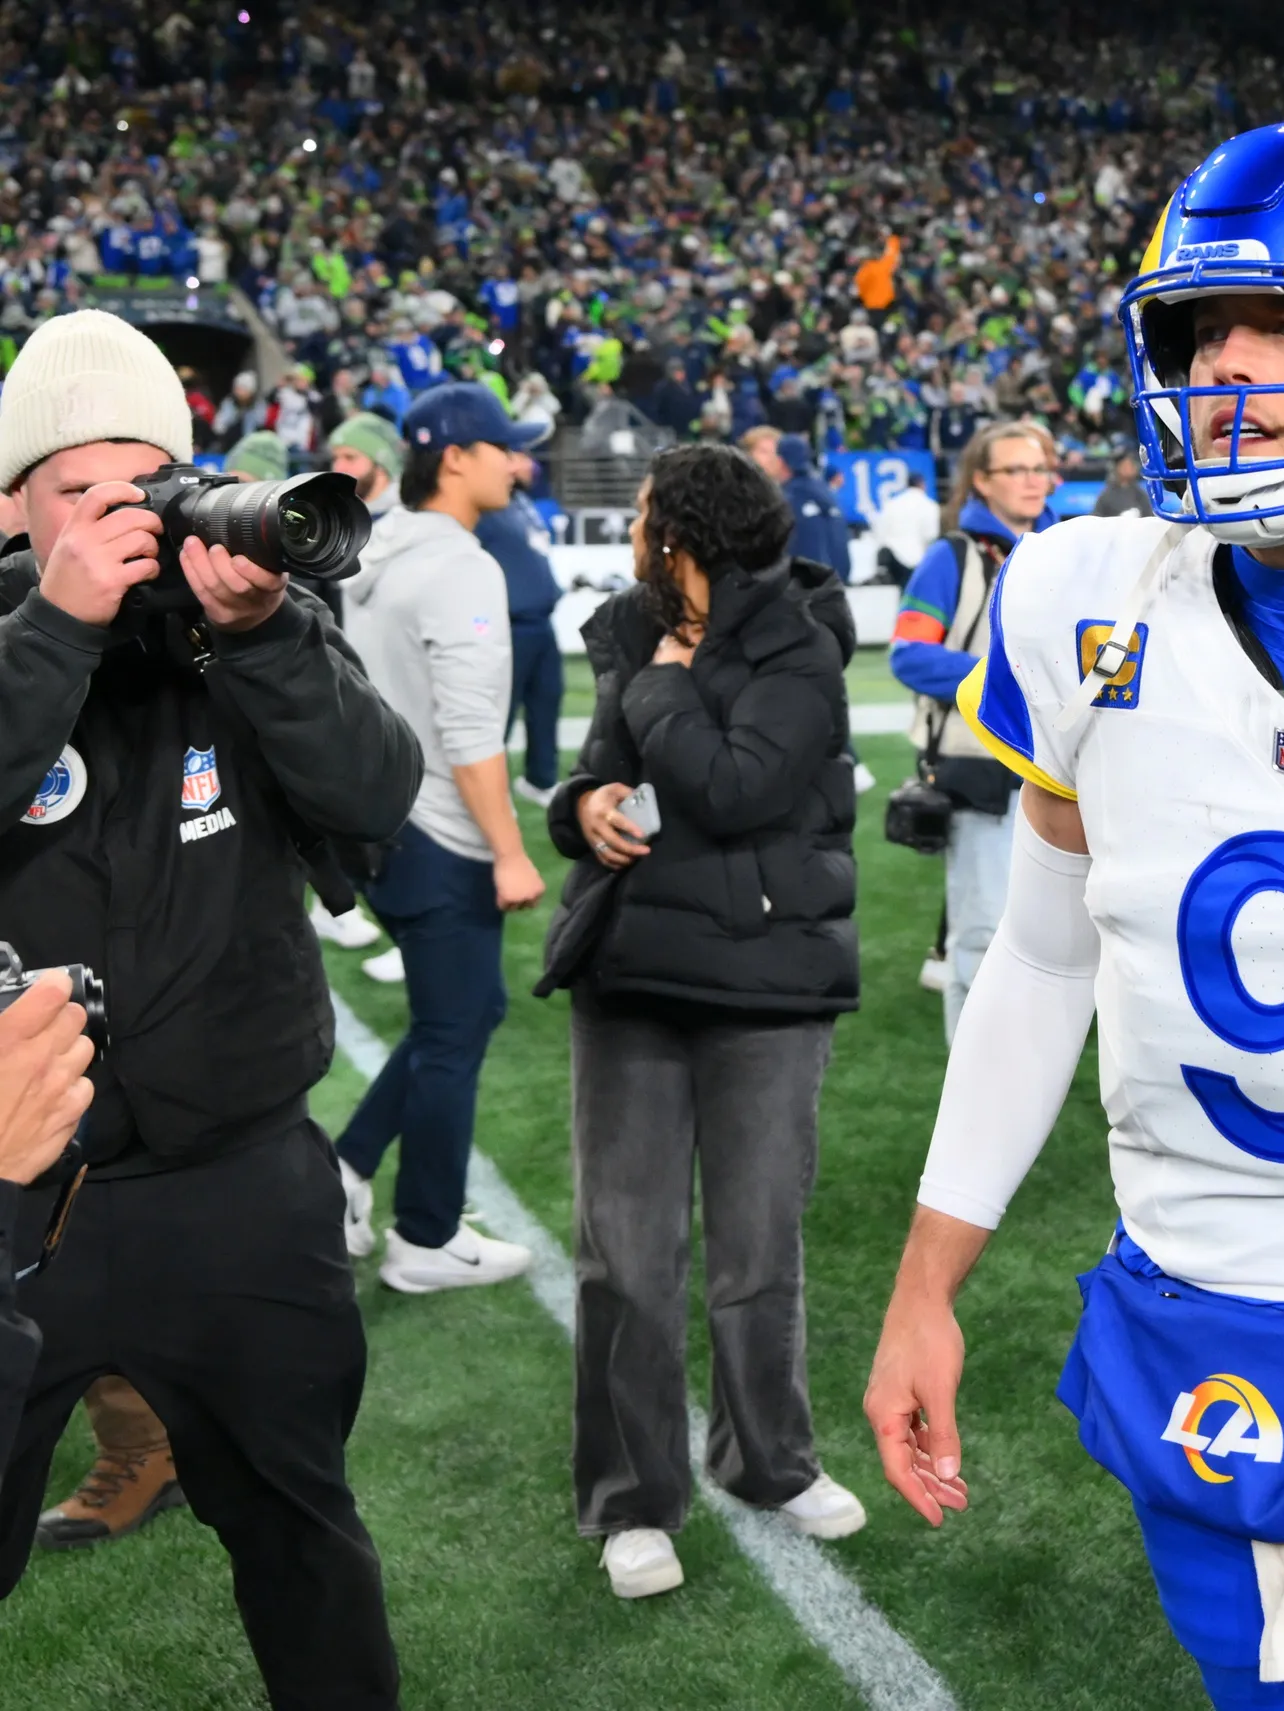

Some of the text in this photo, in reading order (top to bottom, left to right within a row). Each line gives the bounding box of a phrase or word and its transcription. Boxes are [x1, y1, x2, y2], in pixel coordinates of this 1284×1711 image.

[1176, 243, 1239, 261] RAMS
[852, 458, 909, 513] 12
[181, 771, 219, 801] NFL
[179, 807, 237, 844] MEDIA
[1160, 1386, 1284, 1464] LA
